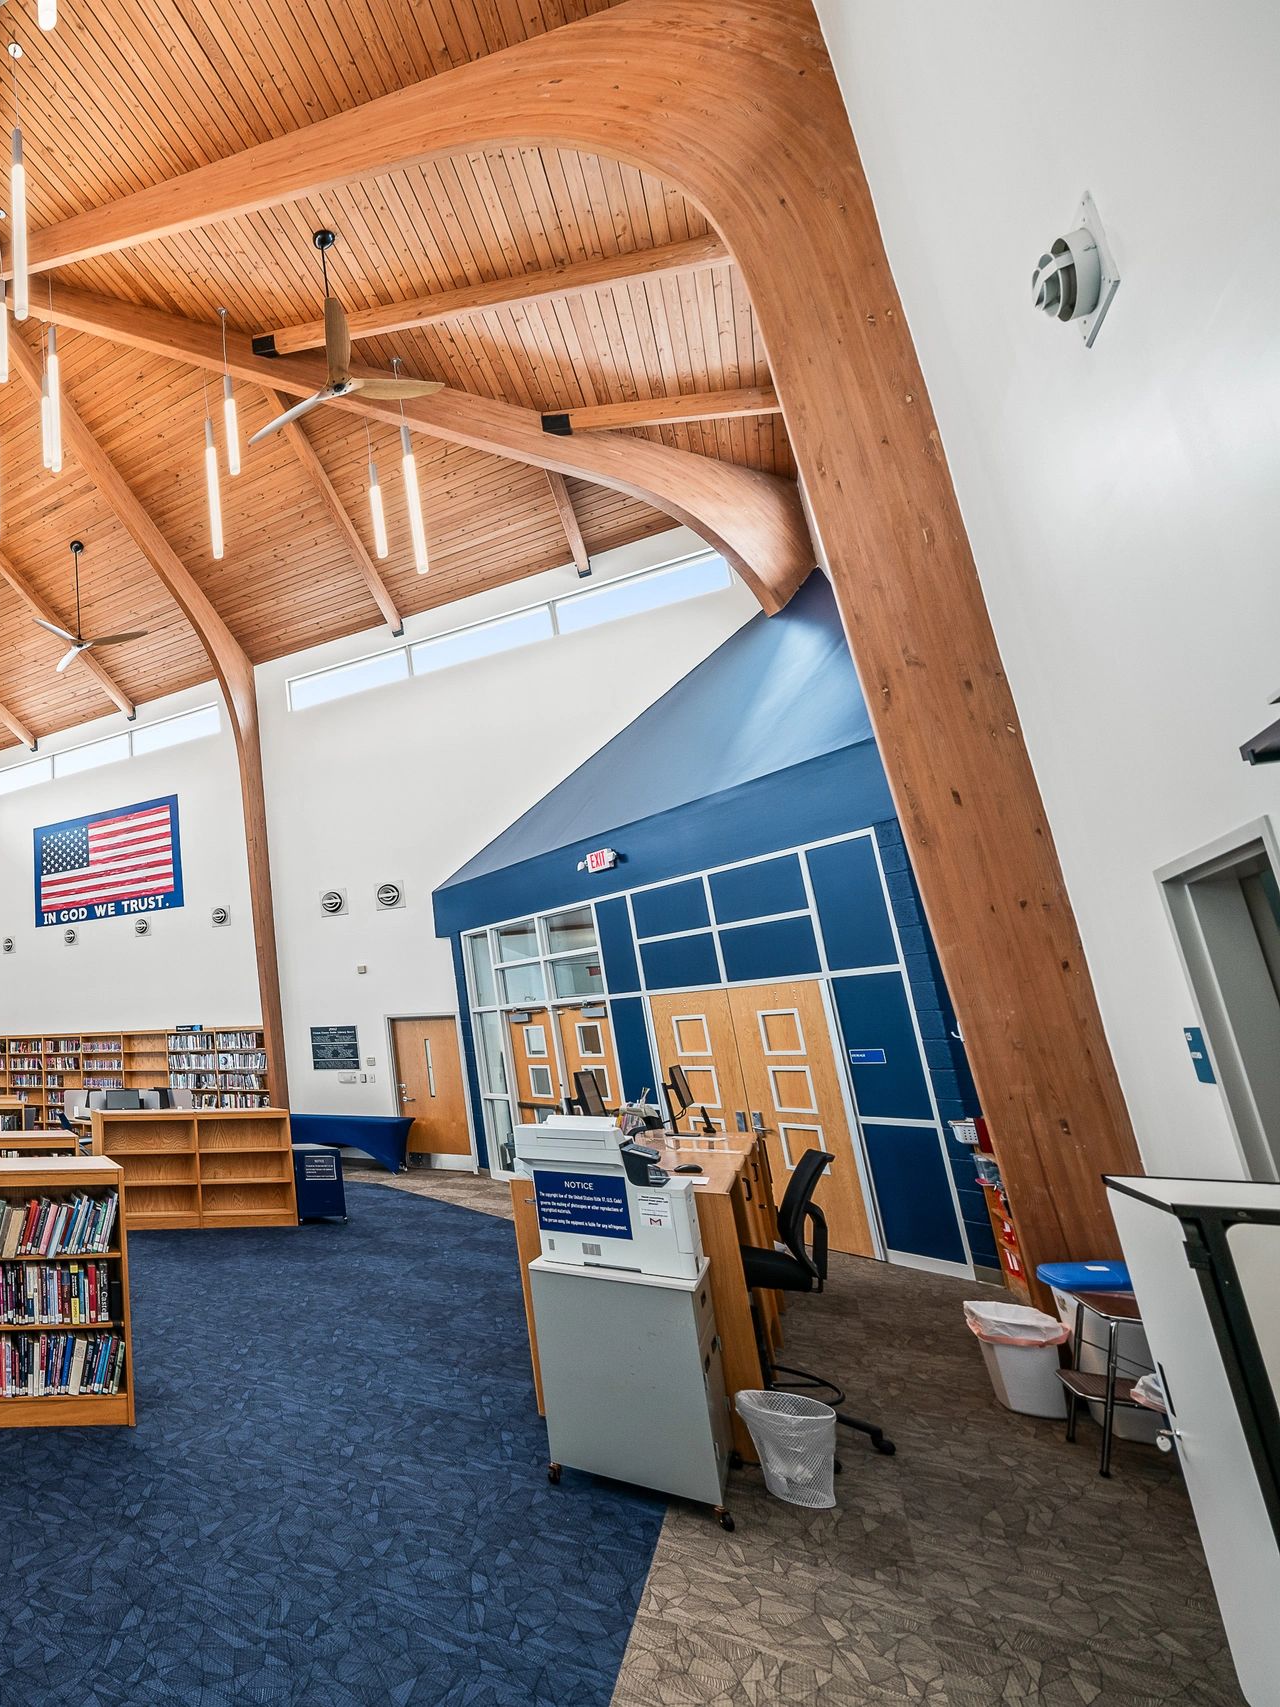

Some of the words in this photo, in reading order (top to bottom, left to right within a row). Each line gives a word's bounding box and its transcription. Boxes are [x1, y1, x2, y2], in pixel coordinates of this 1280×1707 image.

[589, 850, 606, 868] EXIT
[44, 912, 56, 925] IN
[60, 907, 88, 922] GOD
[94, 902, 116, 918] WE
[122, 895, 170, 913] TRUST.
[564, 1180, 594, 1190] NOTICE
